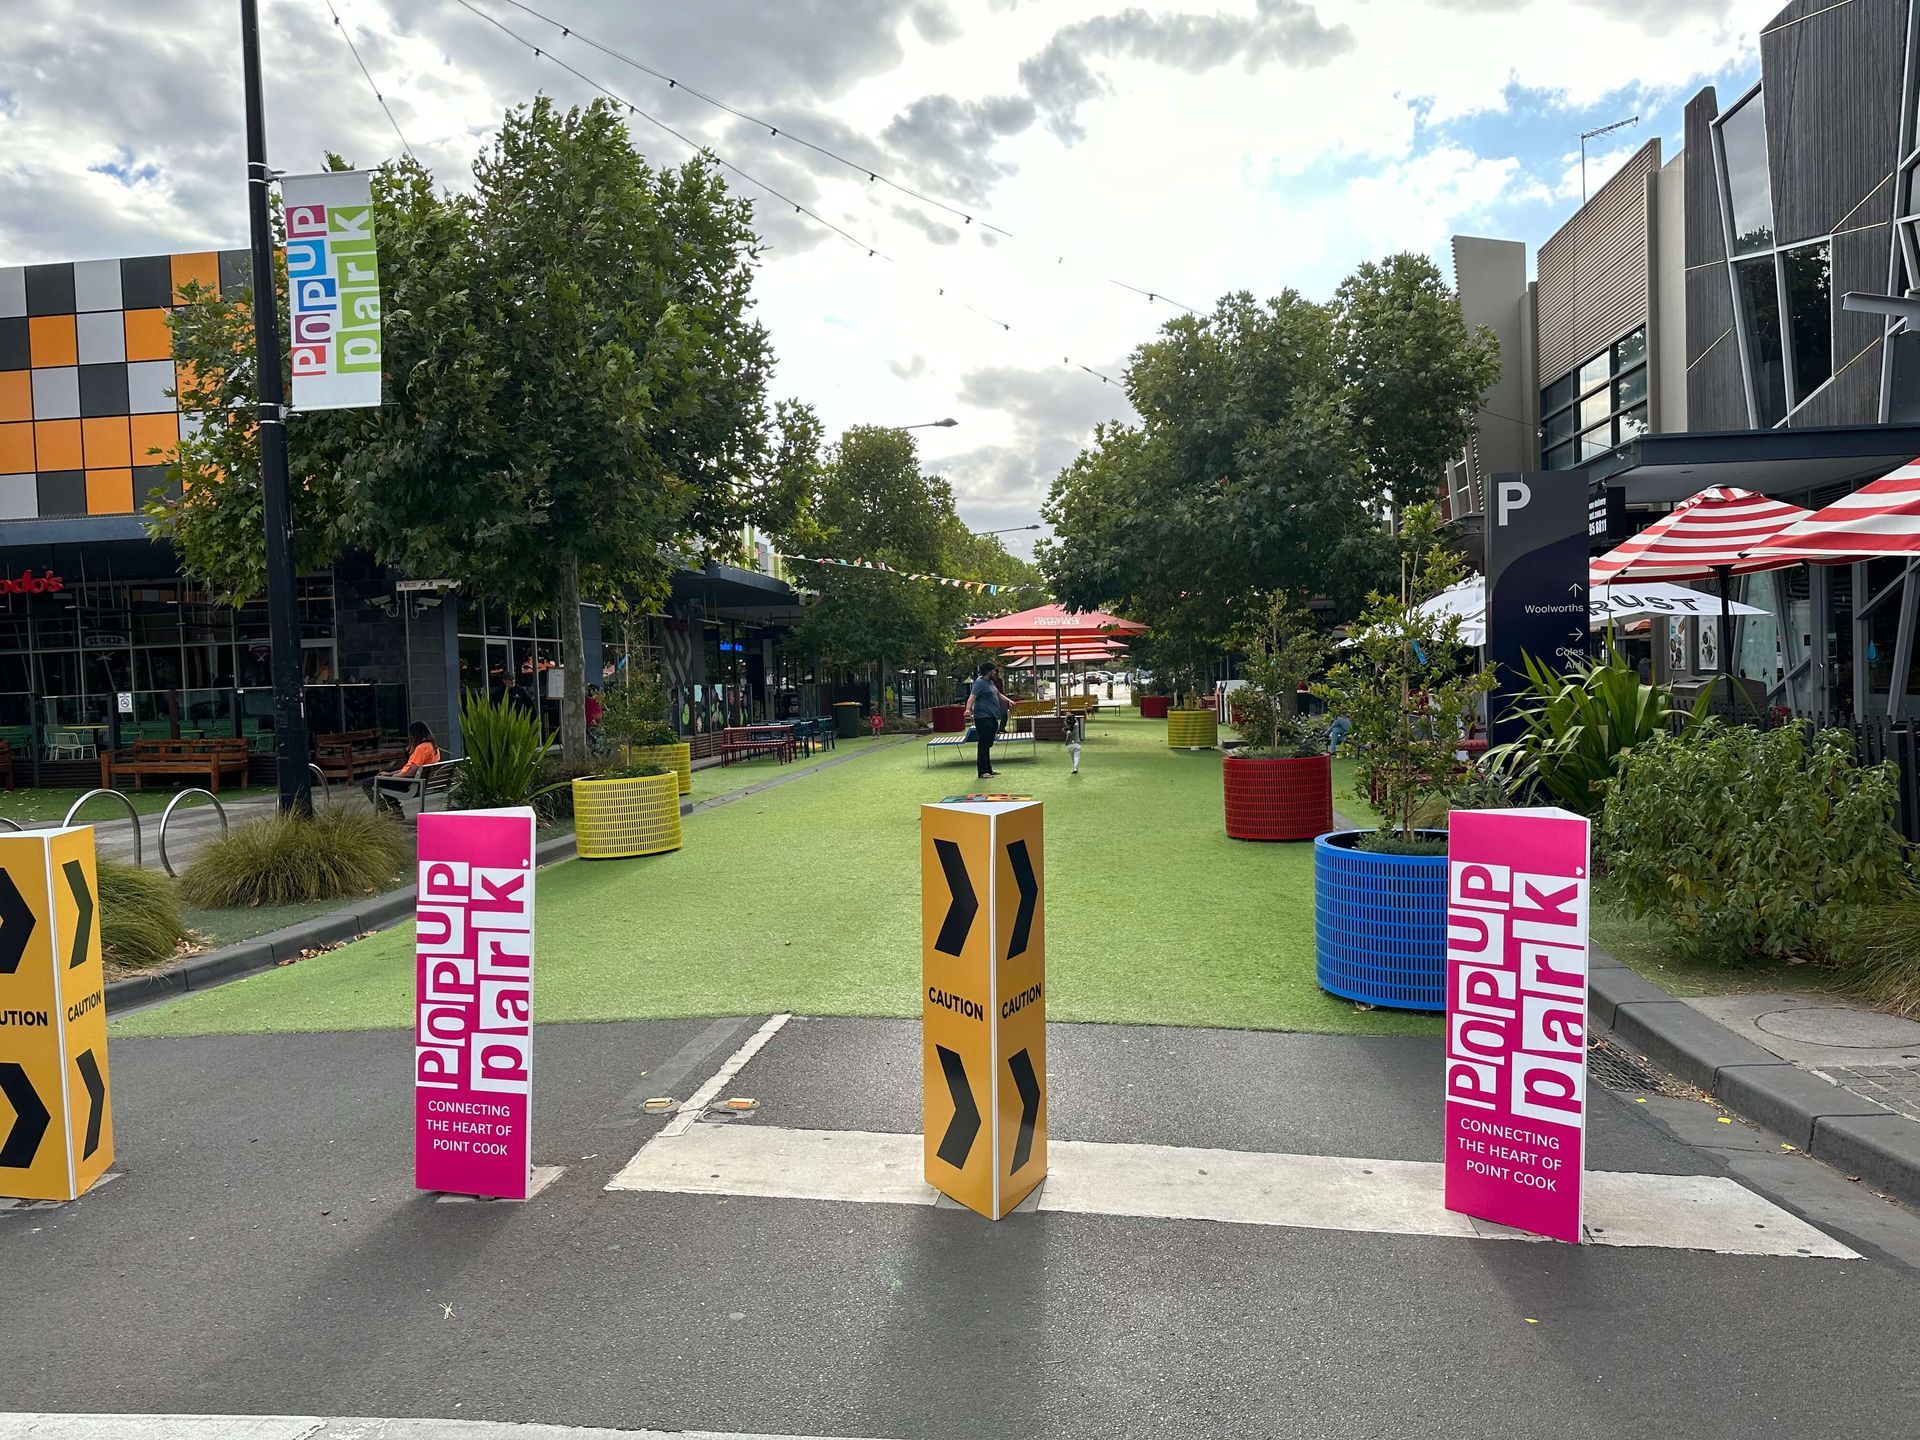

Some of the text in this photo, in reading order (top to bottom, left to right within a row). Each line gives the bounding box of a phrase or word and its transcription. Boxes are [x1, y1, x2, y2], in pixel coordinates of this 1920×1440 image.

[328, 207, 381, 368] park
[1498, 481, 1531, 526] P
[1525, 604, 1584, 613] Woolworths
[1555, 647, 1584, 656] Coles
[471, 871, 529, 1083] park
[67, 989, 102, 1022] CAUTION
[928, 986, 984, 1022] CAUTION
[1001, 982, 1042, 1019] CAUTION
[1513, 879, 1585, 1114] park
[428, 1100, 511, 1117] CONNECTING
[426, 1119, 513, 1137] THE HEART OF
[1460, 1118, 1560, 1150] CONNECTING
[433, 1138, 508, 1156] POINT COOK
[1457, 1137, 1563, 1171] THE HEART OF
[1466, 1159, 1557, 1192] POINT COOK
